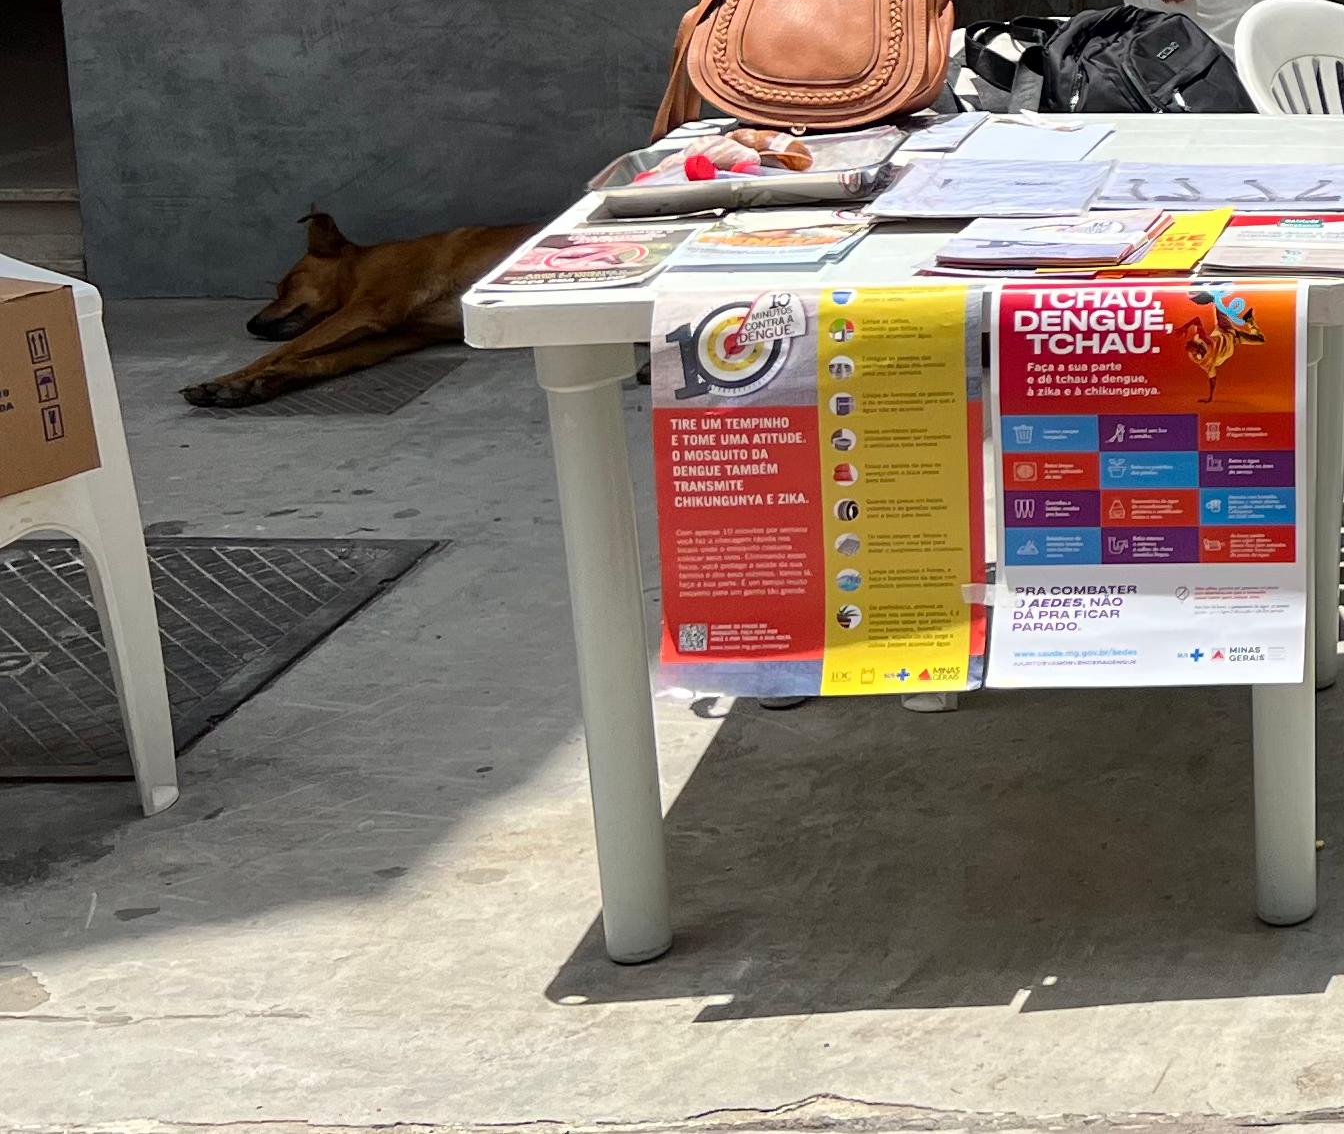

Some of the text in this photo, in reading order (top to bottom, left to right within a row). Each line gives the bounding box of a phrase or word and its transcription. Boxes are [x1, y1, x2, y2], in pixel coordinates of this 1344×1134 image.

[770, 292, 792, 310] 10
[1027, 288, 1161, 310] TCHAU,
[751, 306, 793, 321] MINUTOS
[745, 315, 795, 332] CONTRA A
[1014, 309, 1173, 334] DENGUE,
[1026, 332, 1160, 354] TCHAU.
[1027, 362, 1054, 373] Faça
[1091, 363, 1122, 373] parte
[670, 417, 790, 430] TIRE UM TEMPINHO
[672, 432, 807, 446] E TOME UMA ATITUDE.
[672, 448, 768, 461] O MOSQUITO DA
[673, 462, 778, 477] DENGUE TAMBÉM
[673, 480, 744, 492] TRANSMITE
[675, 493, 809, 507] CHIKUNGUNYA E ZIKA.
[1015, 585, 1137, 596] PRA COMBATER
[1028, 598, 1086, 608] AEDES,
[1089, 594, 1123, 607] NÃO
[1013, 608, 1120, 620] DÁ PRA FICAR
[1012, 622, 1082, 632] PARADO.
[1229, 646, 1261, 654] MINAS
[1229, 654, 1265, 662] GERAIS
